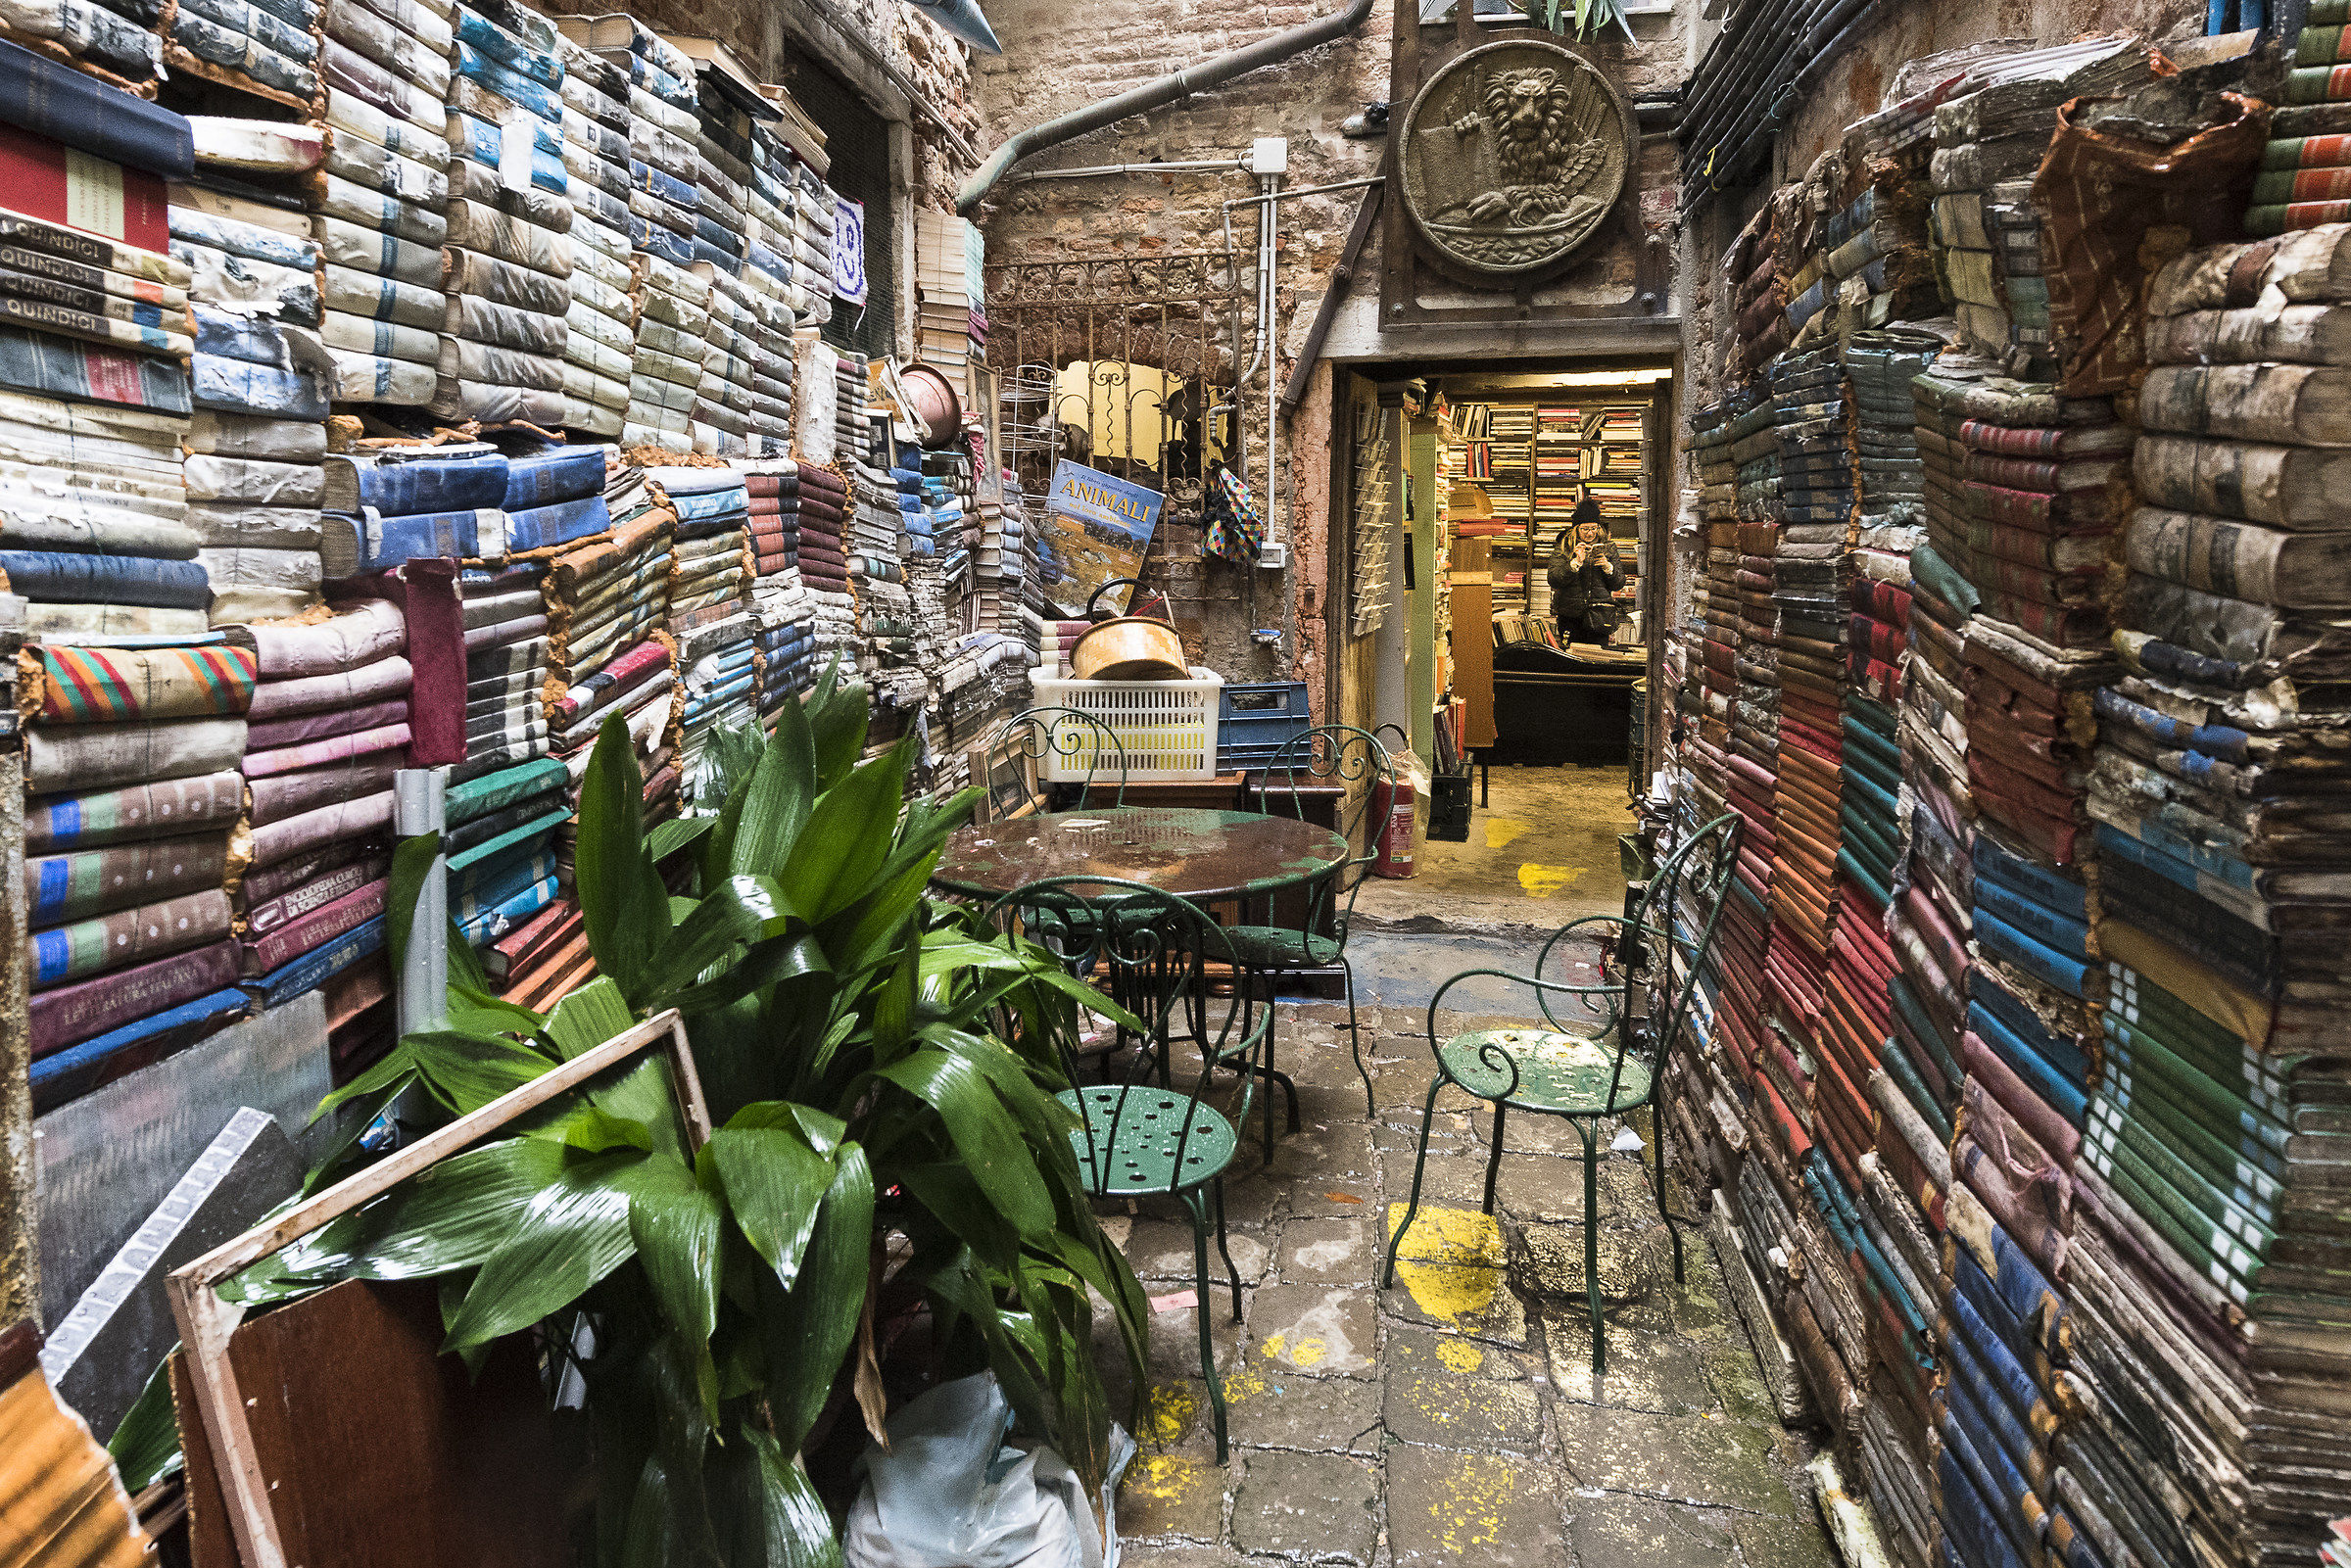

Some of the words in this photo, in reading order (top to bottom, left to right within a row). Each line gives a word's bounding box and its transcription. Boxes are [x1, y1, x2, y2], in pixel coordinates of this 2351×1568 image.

[0, 248, 90, 282] QUINDICI
[5, 276, 91, 309] QUINDICI
[7, 299, 97, 331] QUINDICI
[1059, 478, 1151, 523] ANIMALI
